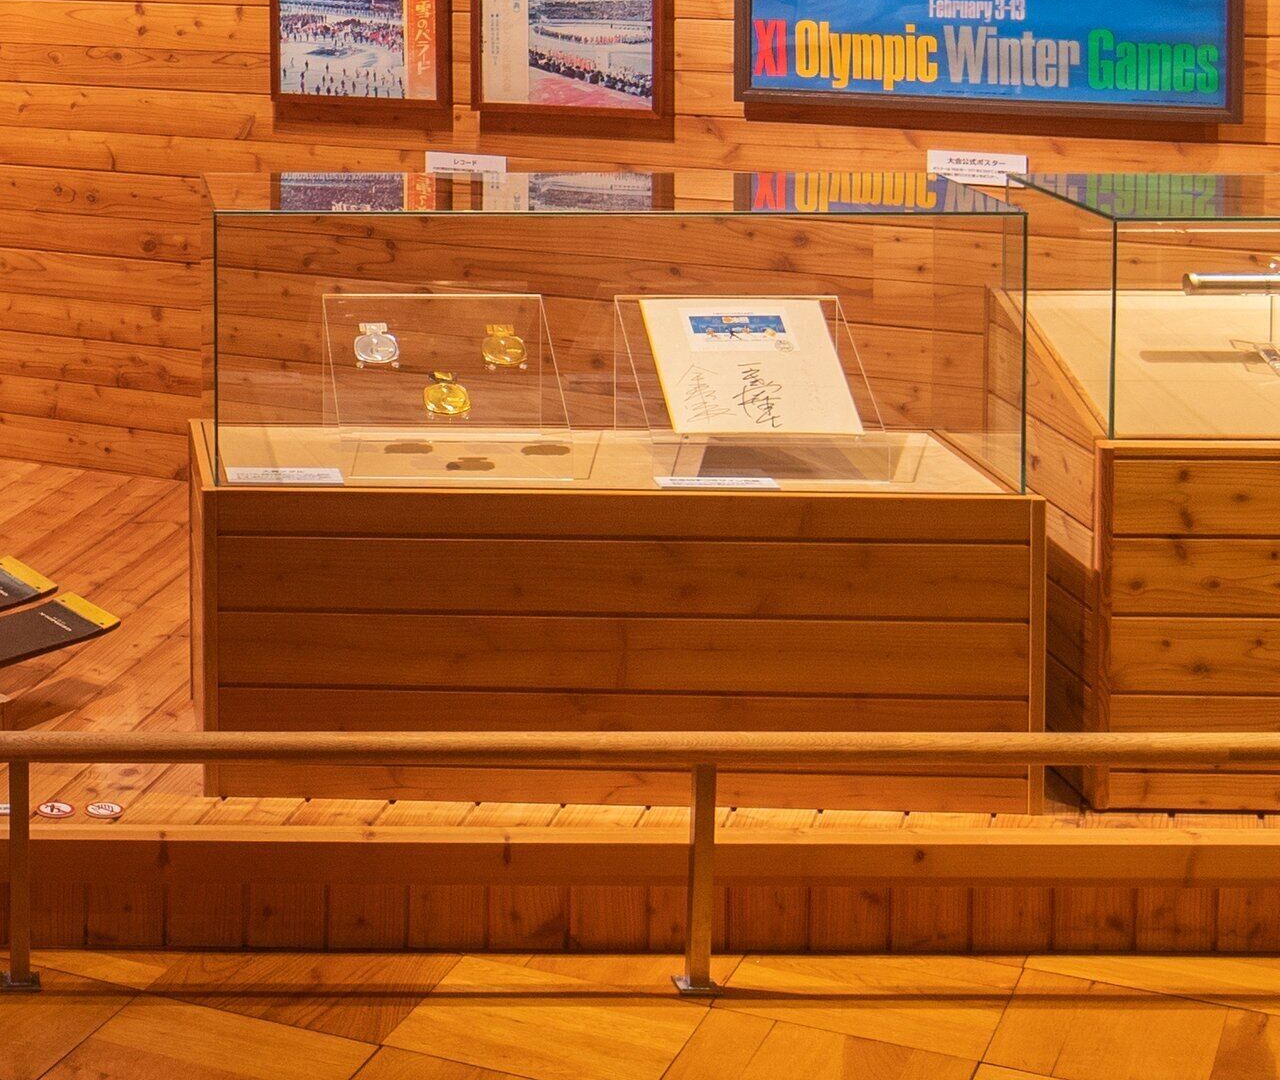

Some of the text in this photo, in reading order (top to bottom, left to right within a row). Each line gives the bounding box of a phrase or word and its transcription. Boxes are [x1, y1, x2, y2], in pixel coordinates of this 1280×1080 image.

[752, 18, 1220, 95] XI Olympic Winter Games
